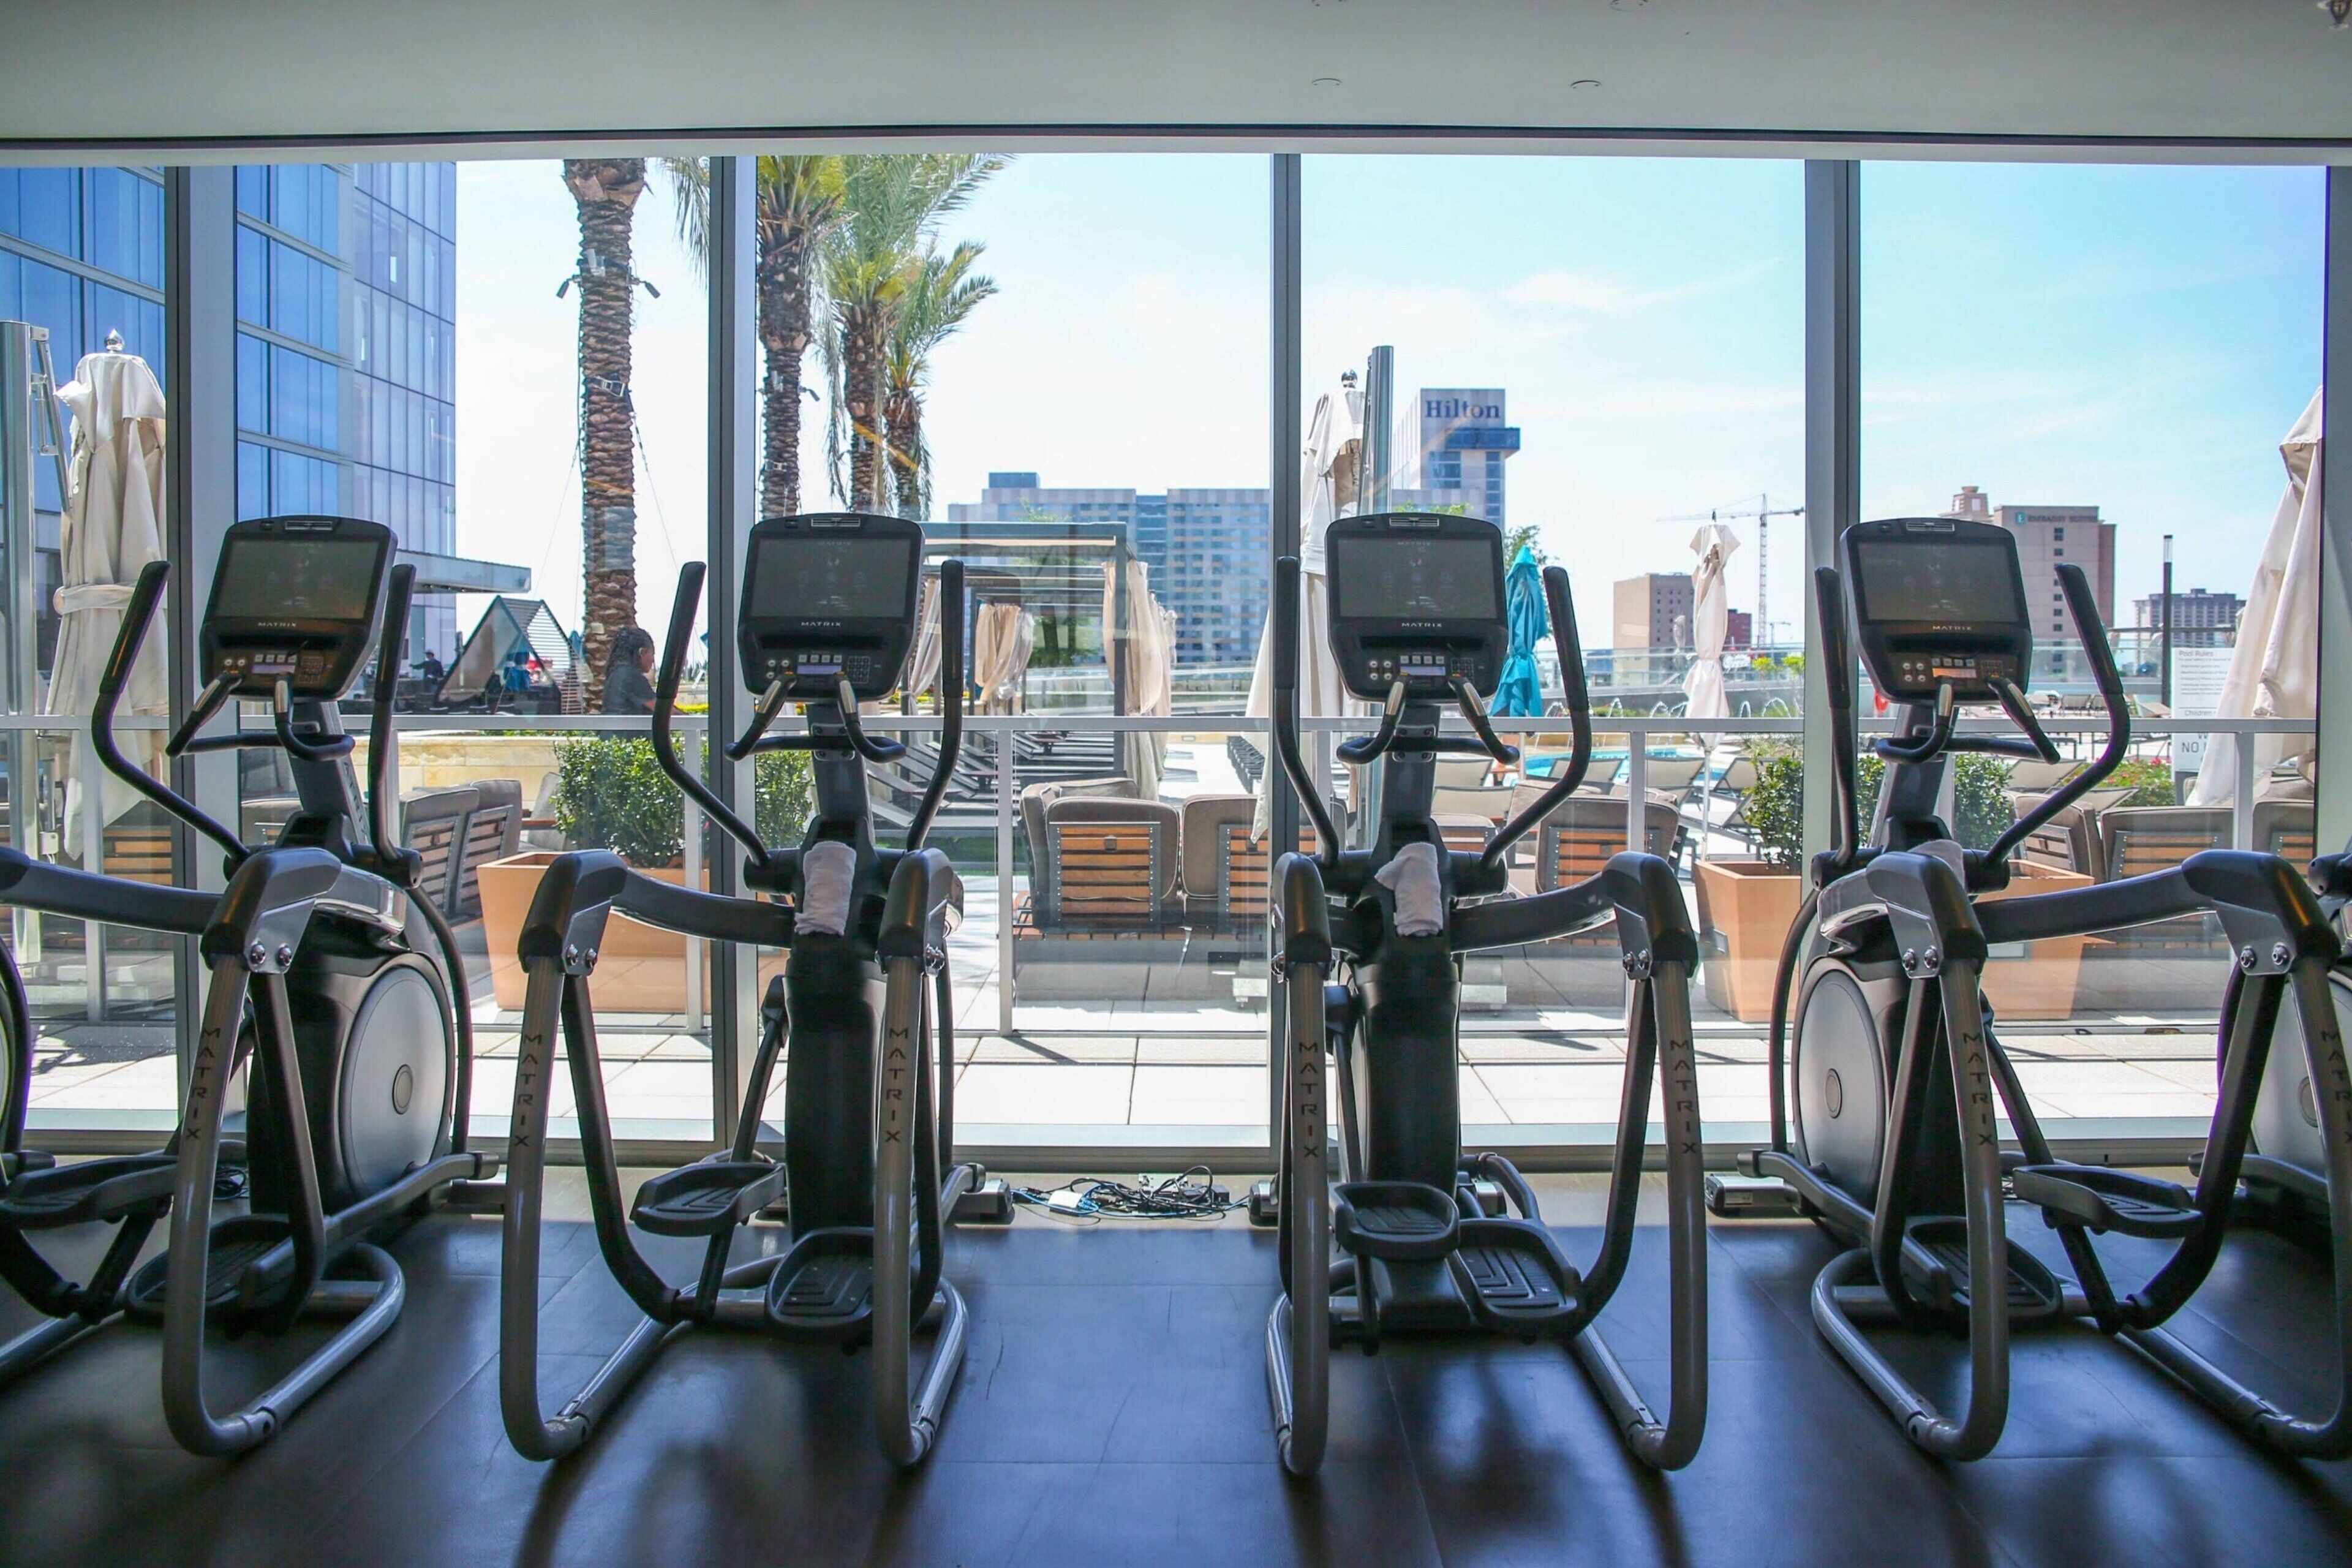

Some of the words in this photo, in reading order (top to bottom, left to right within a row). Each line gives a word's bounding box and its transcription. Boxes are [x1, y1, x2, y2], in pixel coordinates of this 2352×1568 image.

[1425, 399, 1500, 418] Hilton
[2182, 742, 2199, 753] NO
[186, 1027, 221, 1139] MATRIX
[514, 1034, 542, 1147] MATRIX
[885, 1028, 908, 1142] MATRIX
[1298, 1042, 1319, 1158] MATRIX
[1670, 1040, 1697, 1154] MATRIX
[1962, 1033, 1995, 1145] MATRIX
